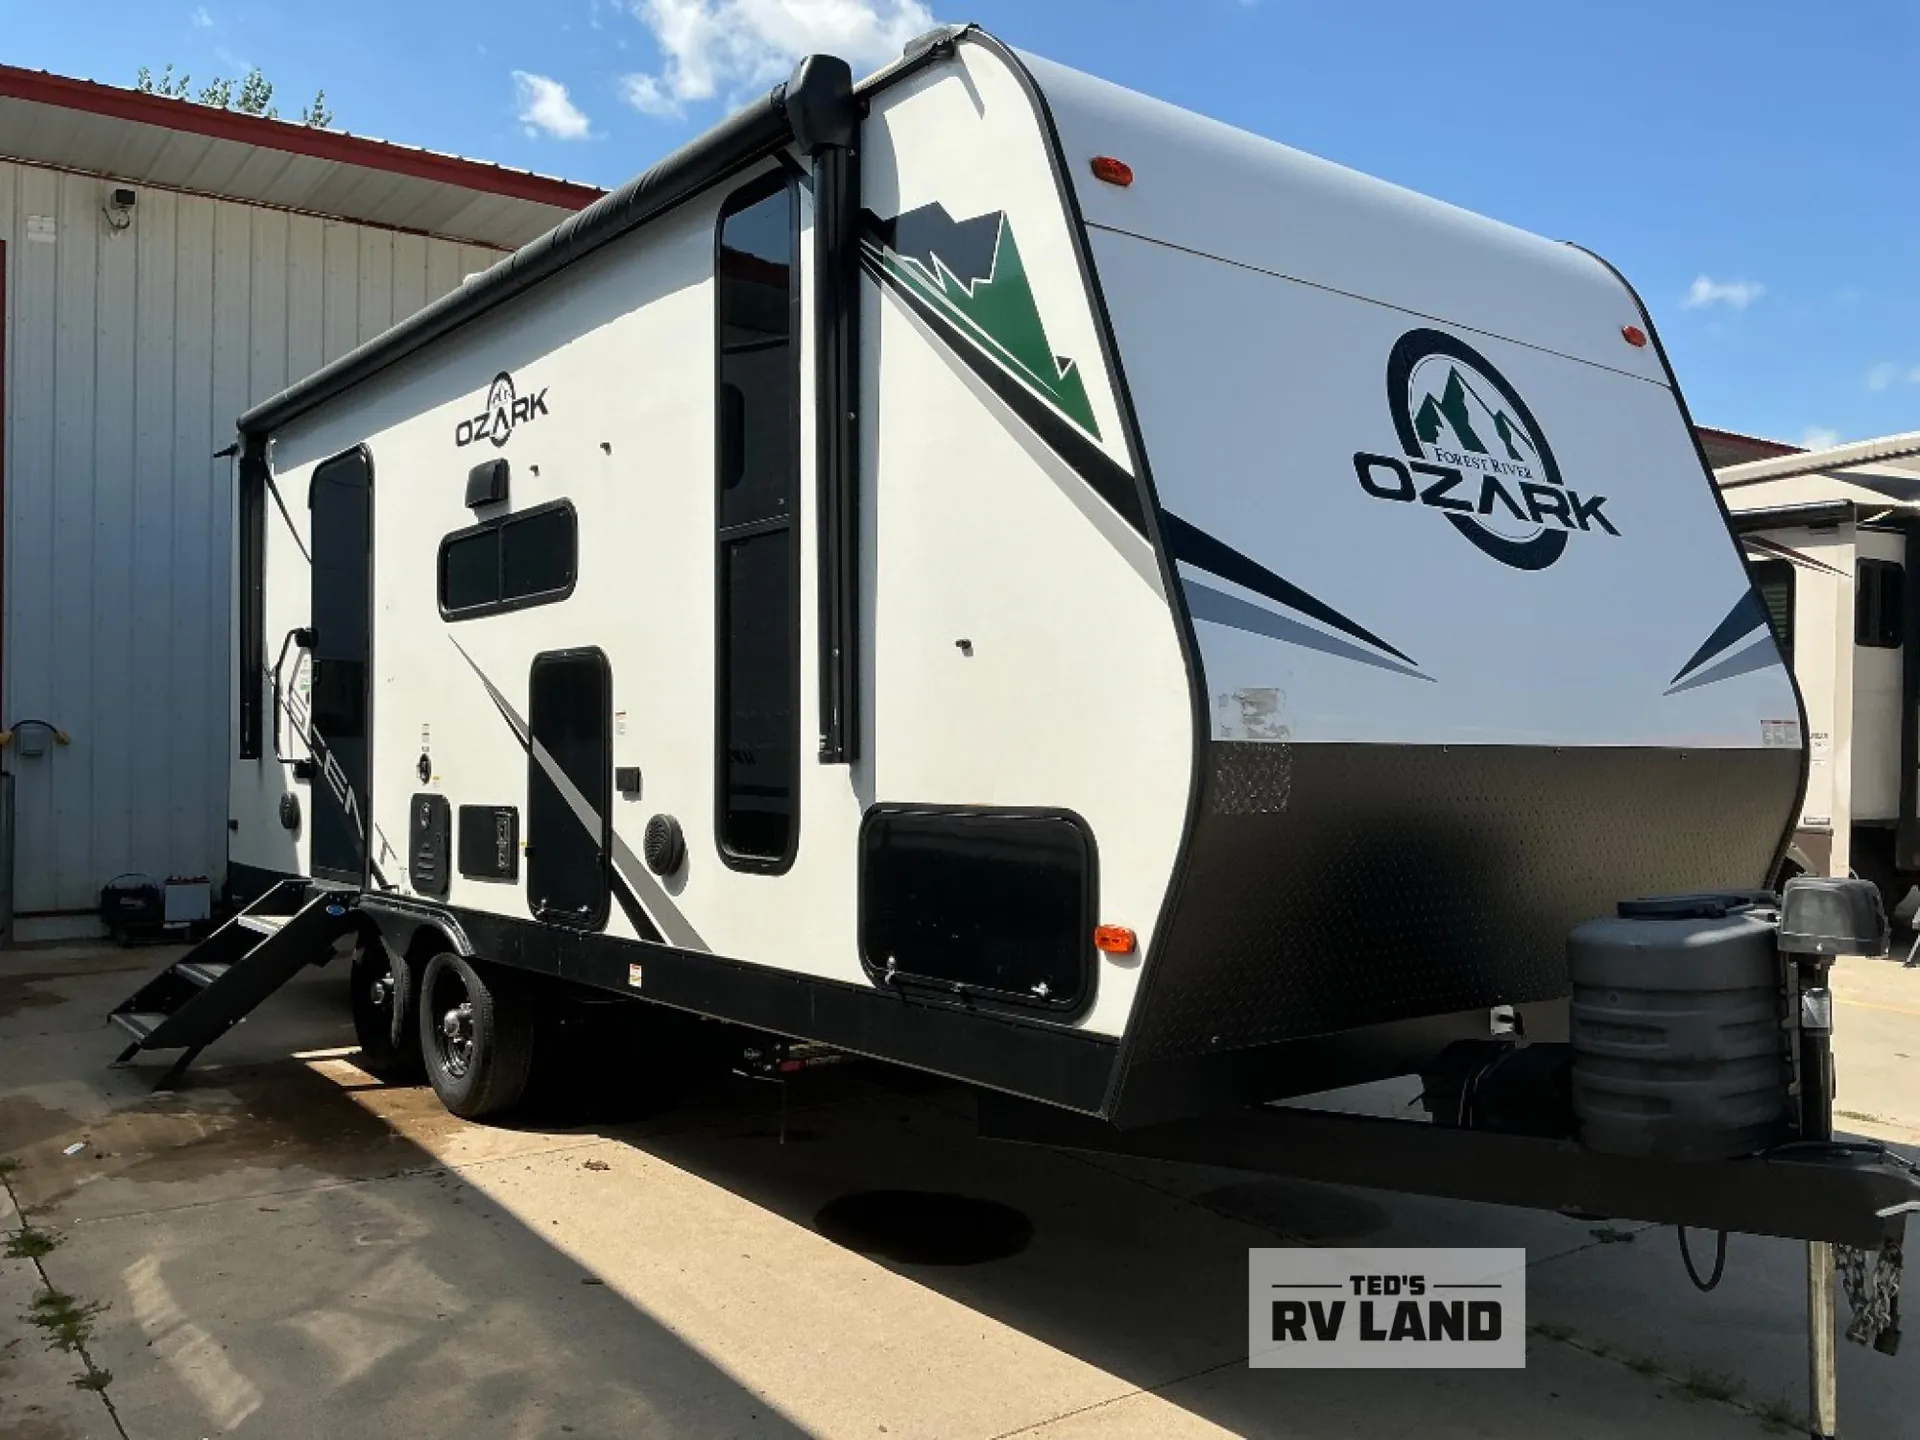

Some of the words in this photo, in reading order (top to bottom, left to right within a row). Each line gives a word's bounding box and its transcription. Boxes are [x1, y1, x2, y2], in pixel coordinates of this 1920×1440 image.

[456, 385, 550, 447] OZARK
[1353, 451, 1622, 536] OZARK
[1432, 446, 1489, 471] FOREST
[1489, 457, 1533, 479] RIVER
